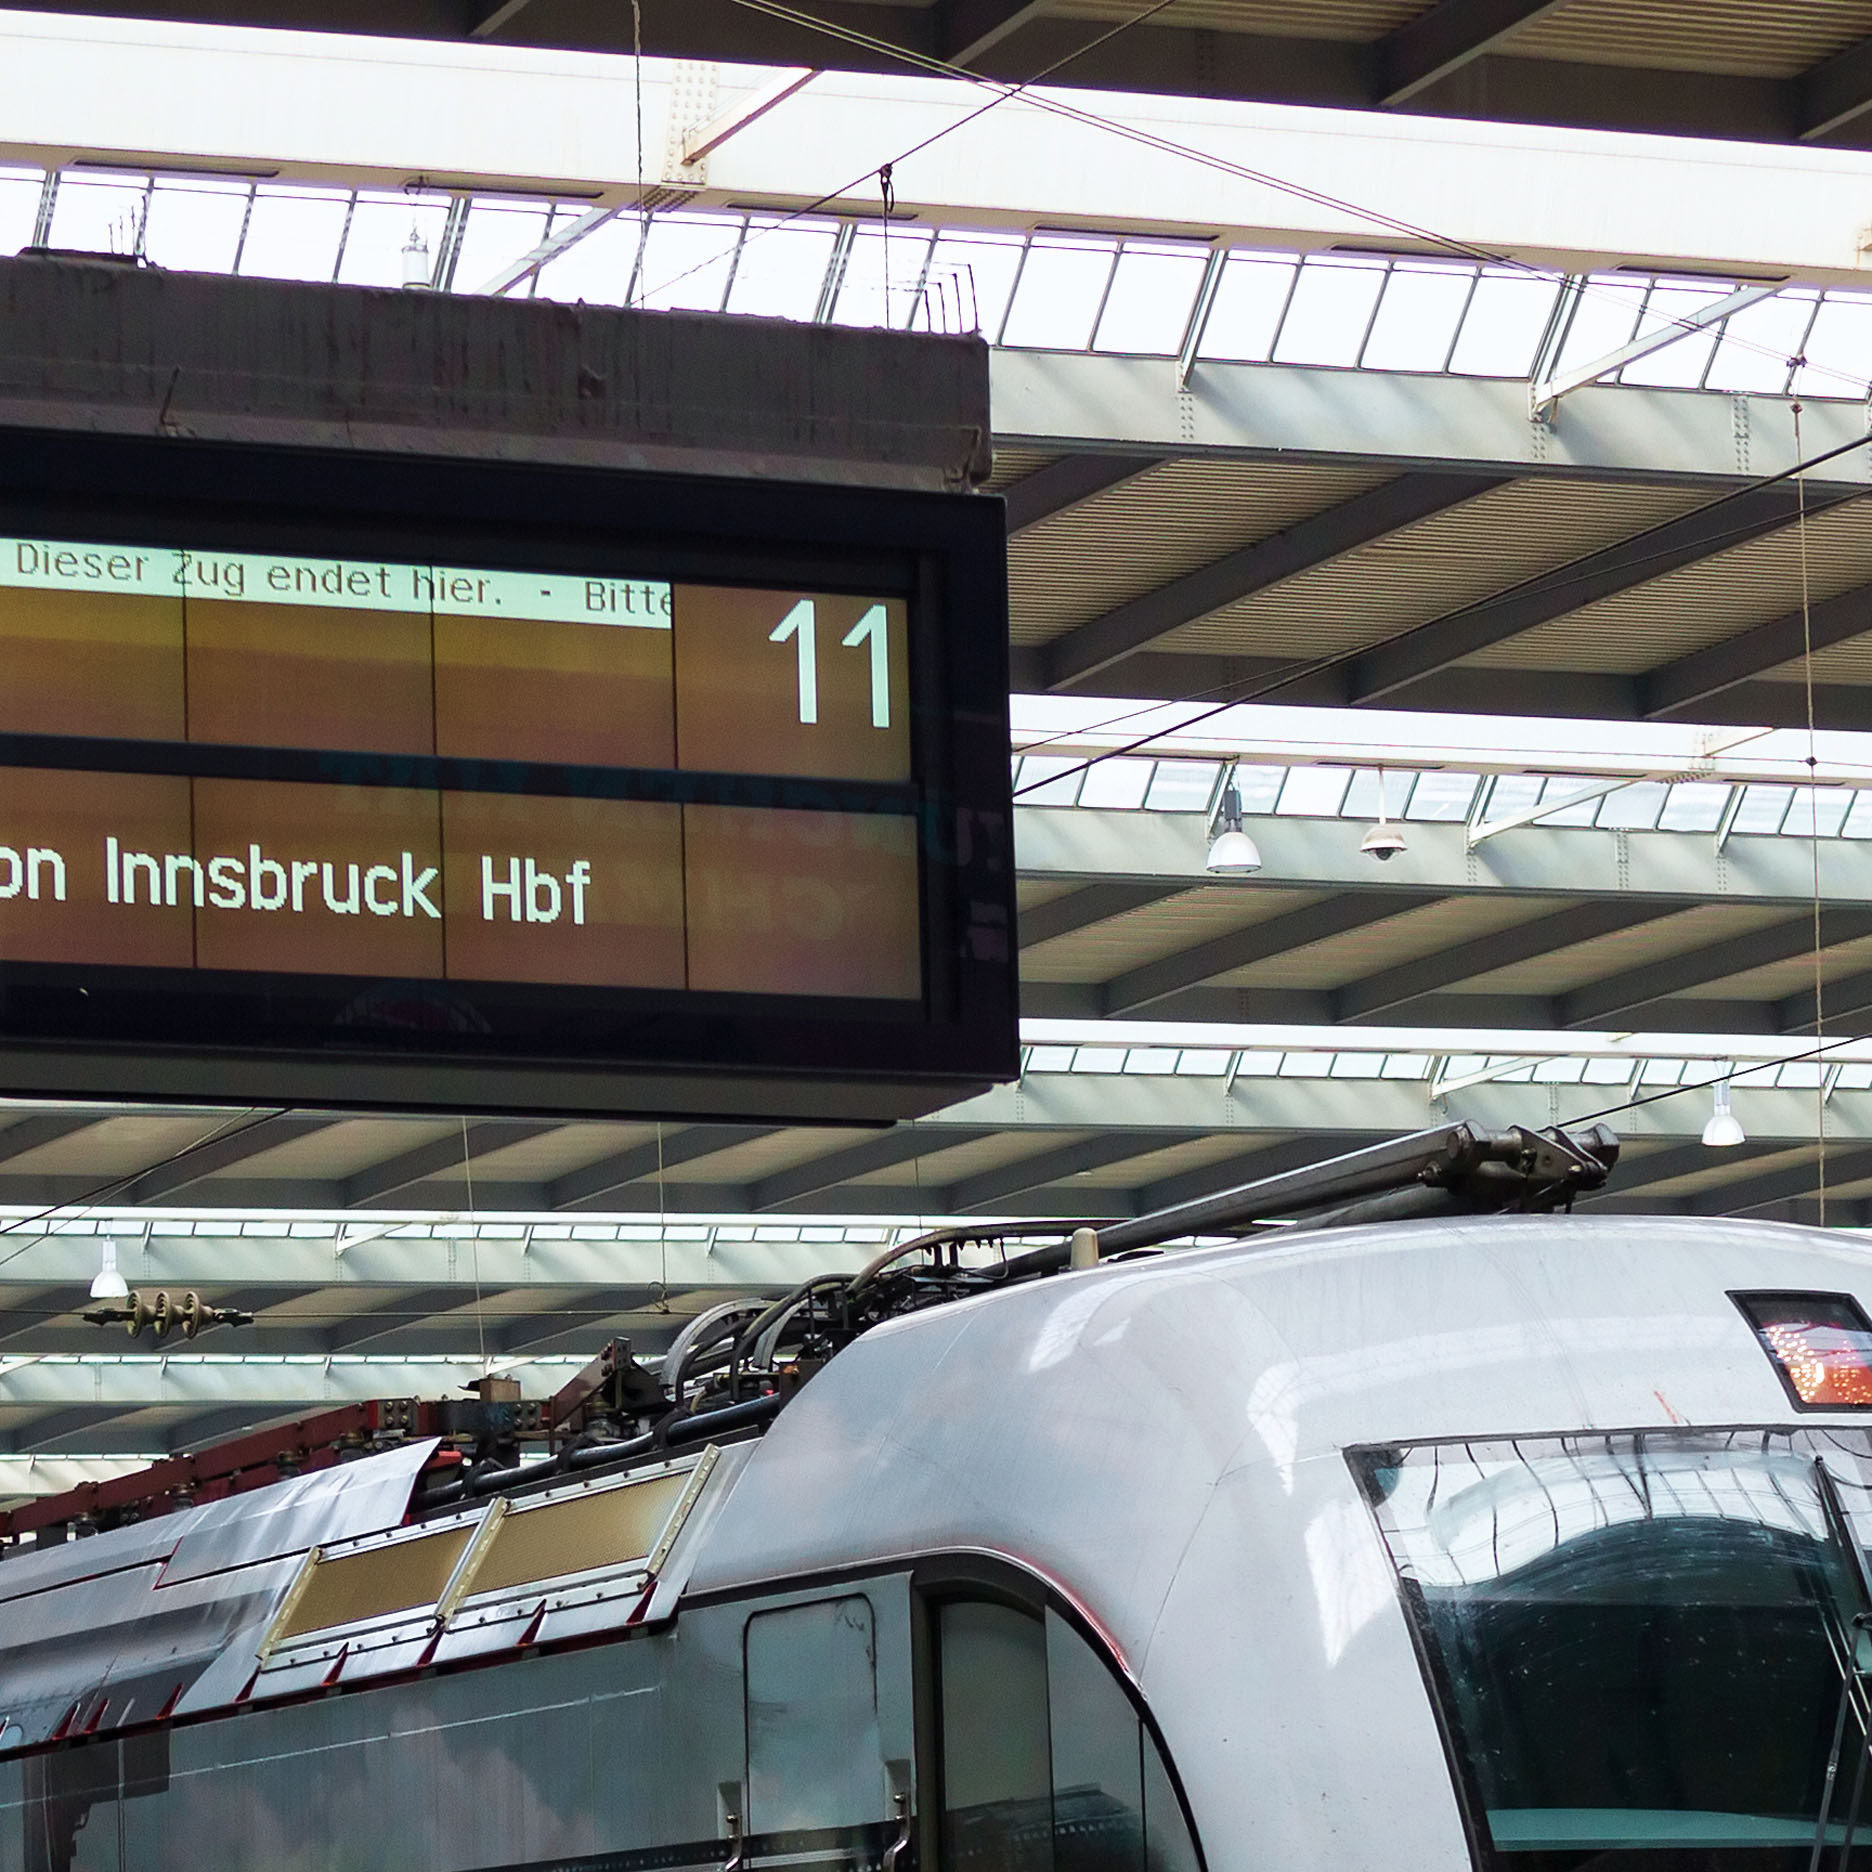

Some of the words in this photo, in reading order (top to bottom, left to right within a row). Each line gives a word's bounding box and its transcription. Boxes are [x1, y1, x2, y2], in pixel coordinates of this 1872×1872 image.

[18, 543, 149, 582] Dieser
[172, 551, 245, 596] Zug
[268, 564, 392, 599] endet
[413, 568, 502, 605] hier.
[769, 599, 889, 728] 11
[106, 837, 441, 919] Innsbruck
[482, 855, 591, 924] Hbf
